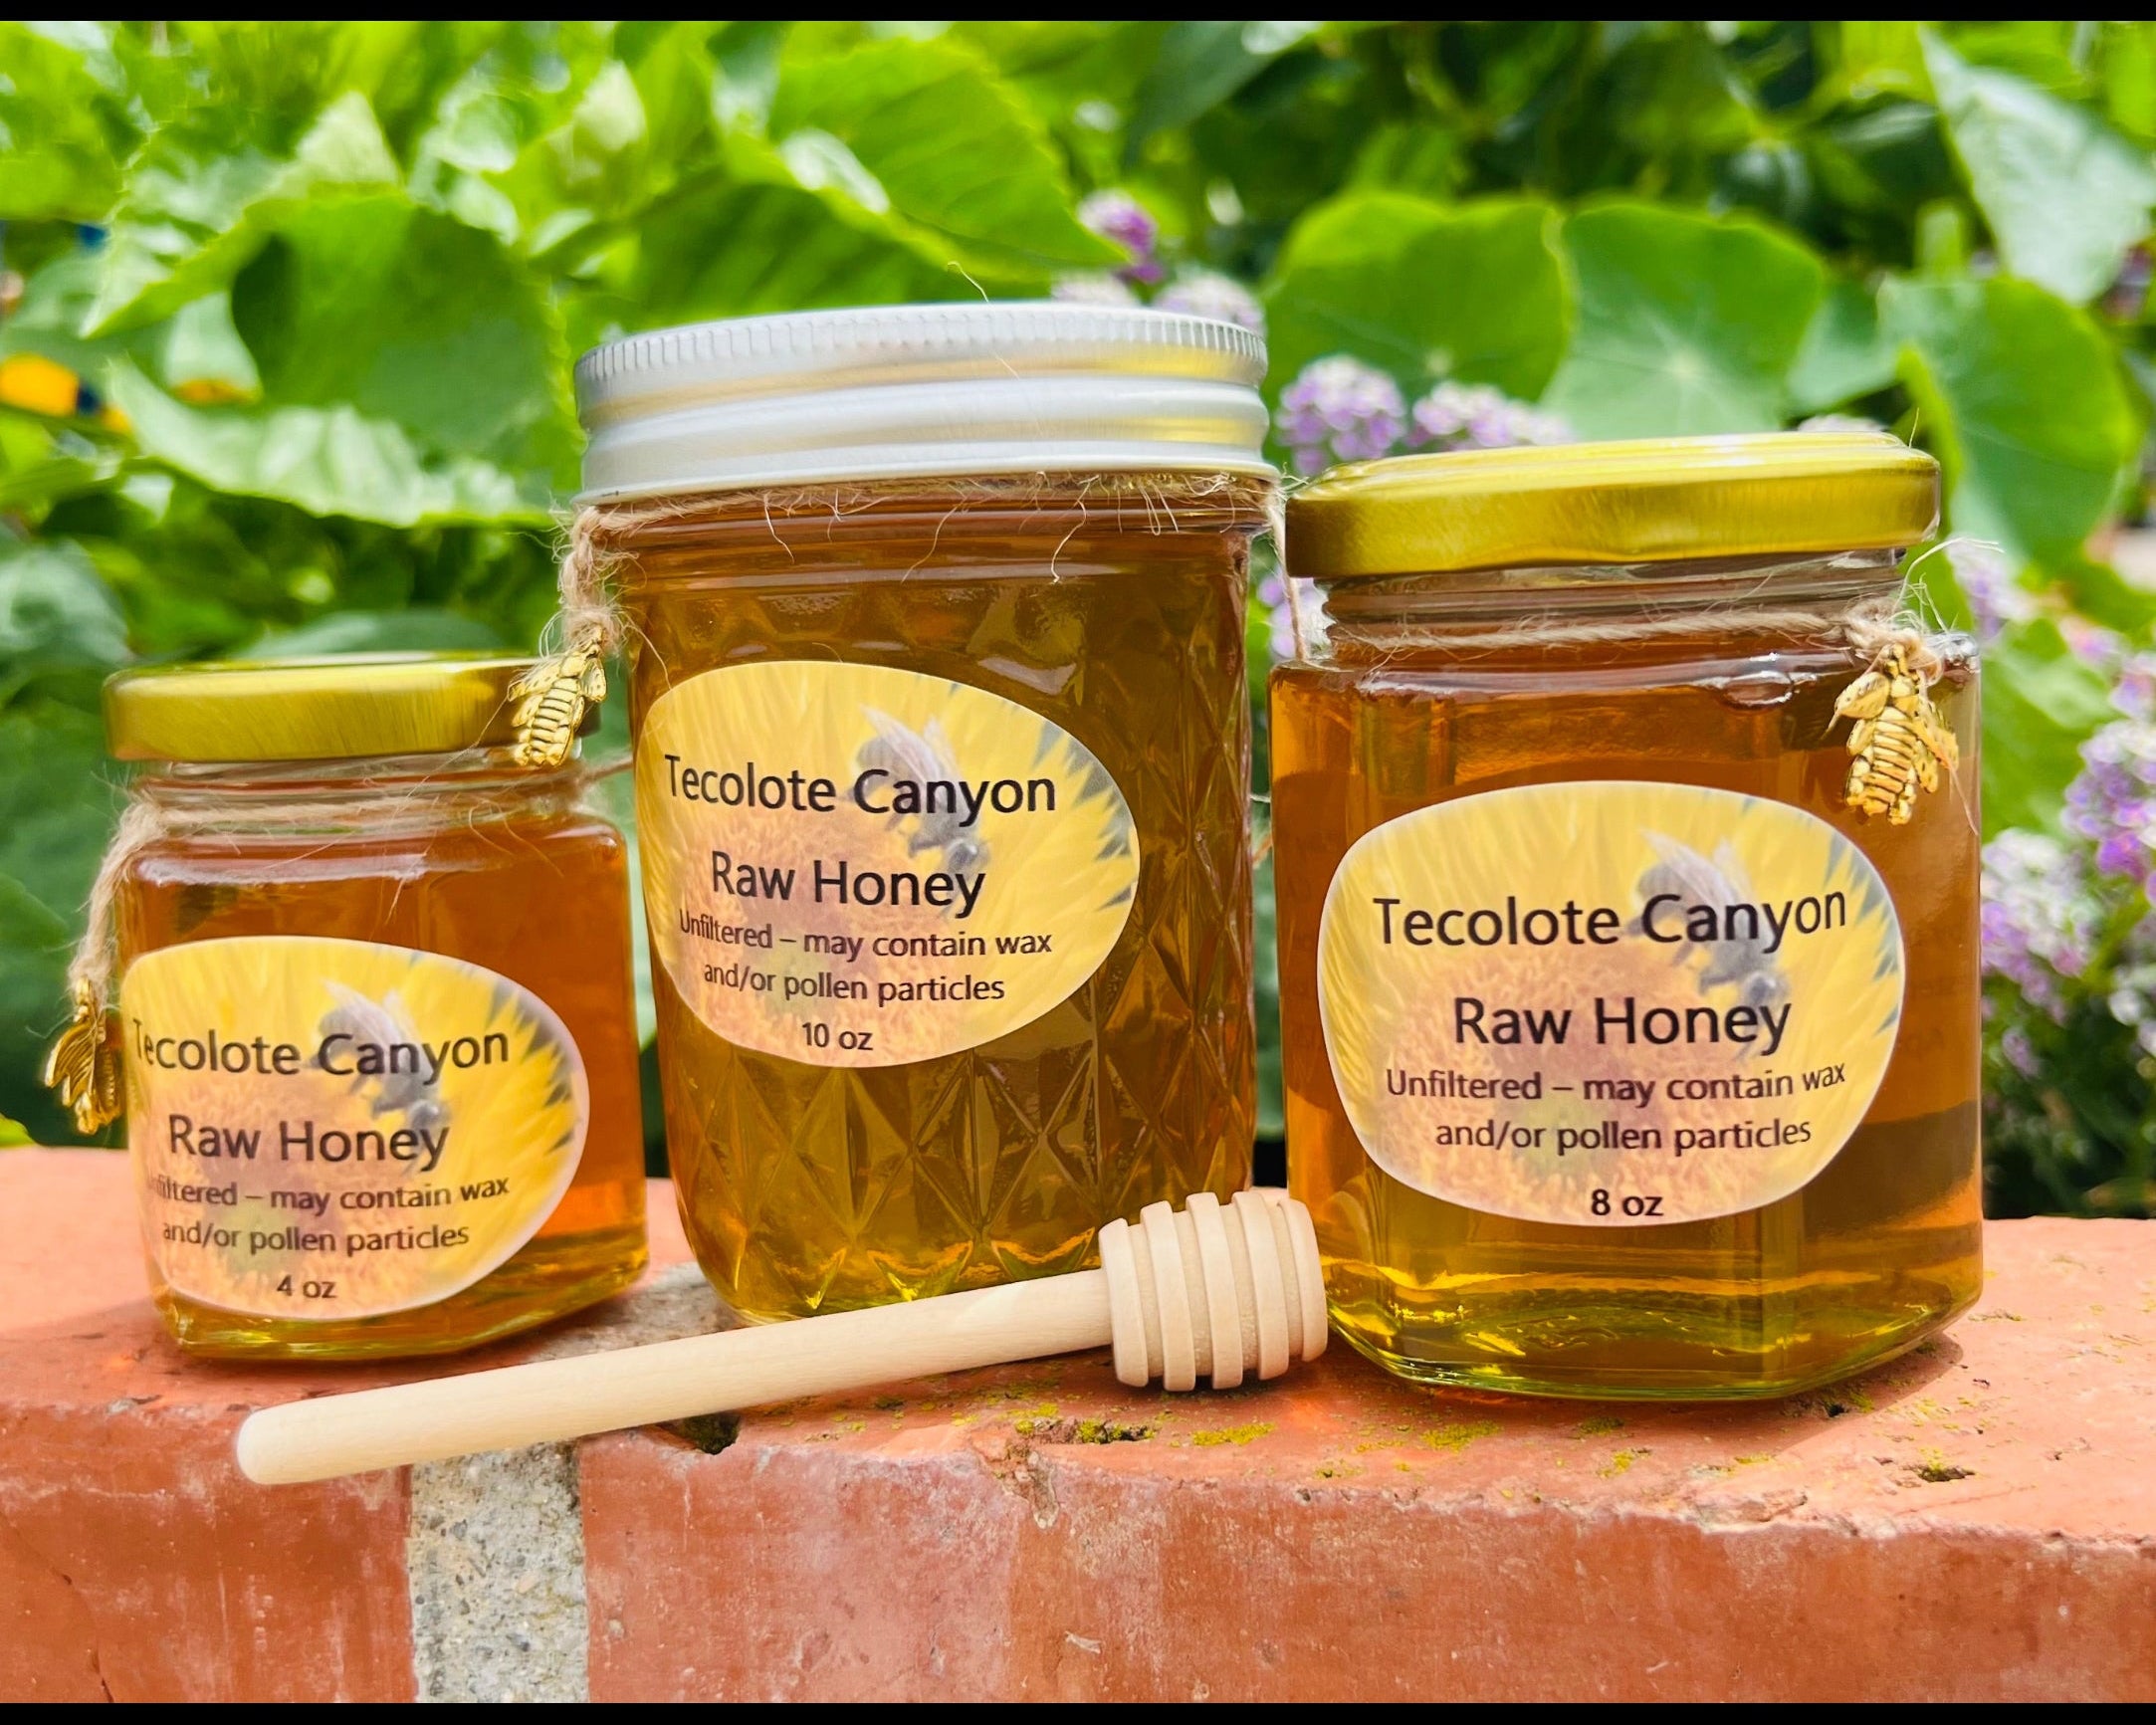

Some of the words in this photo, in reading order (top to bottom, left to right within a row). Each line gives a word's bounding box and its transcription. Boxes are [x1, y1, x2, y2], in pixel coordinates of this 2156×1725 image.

[665, 755, 835, 812] Tecolote
[854, 768, 1056, 827] Canyon
[712, 851, 795, 900] Raw
[814, 860, 985, 918] Honey
[680, 909, 772, 950] Unfiltered
[804, 933, 863, 963] may
[873, 932, 985, 957] contain
[996, 935, 1052, 954] wax
[1373, 896, 1619, 946] Tecolote
[1642, 891, 1845, 953] Canyon
[704, 962, 773, 992] and/or
[785, 971, 867, 1001] pollen
[879, 975, 1005, 1006] particles
[802, 1023, 828, 1047] 10
[839, 1029, 873, 1050] oz
[1456, 997, 1572, 1044] Raw
[1595, 997, 1792, 1056] Honey
[132, 1018, 301, 1075] Tecolote
[318, 1031, 509, 1085] Canyon
[1387, 1069, 1542, 1100] Unfiltered
[1584, 1080, 1654, 1108] may
[1666, 1070, 1793, 1098] contain
[1803, 1062, 1845, 1090] wax
[169, 1114, 261, 1160] Raw
[280, 1121, 449, 1172] Honey
[1436, 1121, 1543, 1151] and/or
[1558, 1124, 1661, 1155] pollen
[1674, 1119, 1812, 1156] particles
[271, 1189, 329, 1216] may
[340, 1182, 451, 1209] contain
[460, 1177, 510, 1197] wax
[1592, 1190, 1611, 1216] 8
[1622, 1195, 1663, 1217] oz
[163, 1220, 240, 1247] and/or
[251, 1227, 335, 1255] pollen
[347, 1223, 469, 1256] particles
[277, 1277, 293, 1296] 4
[303, 1279, 336, 1299] oz
